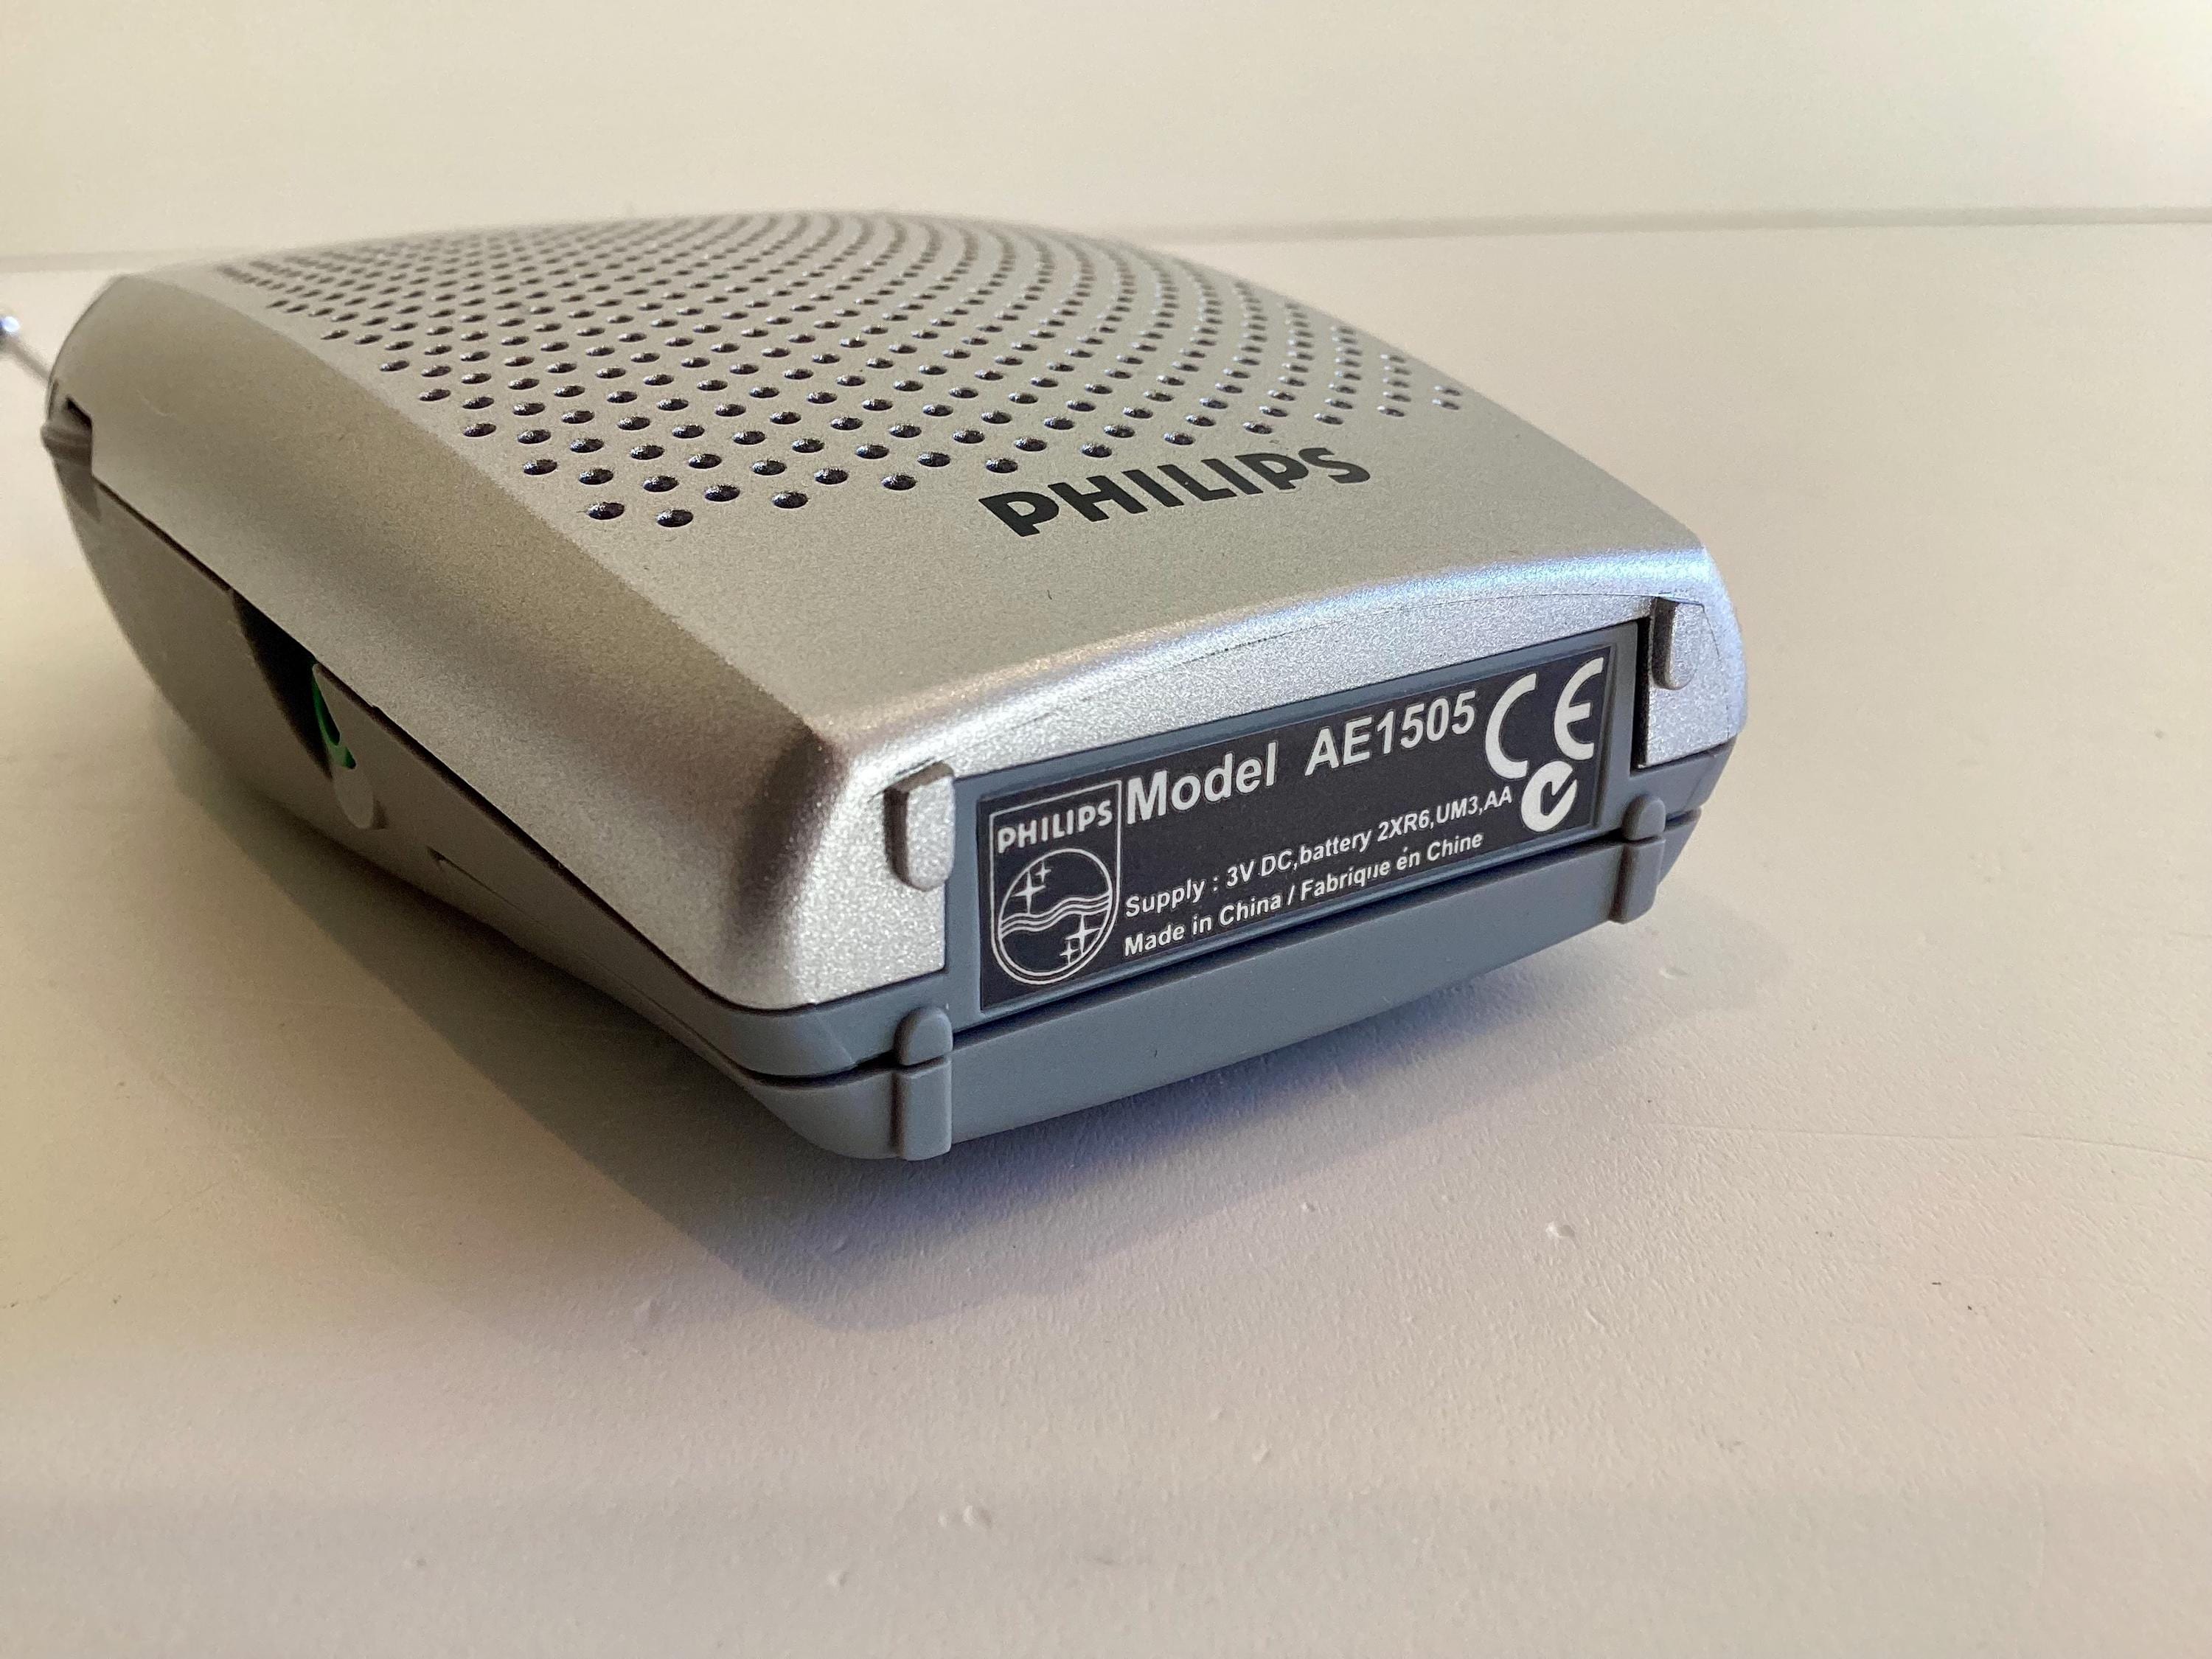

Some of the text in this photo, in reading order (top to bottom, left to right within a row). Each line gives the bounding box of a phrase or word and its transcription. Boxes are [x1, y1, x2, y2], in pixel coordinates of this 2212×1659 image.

[978, 448, 1371, 537] PHILIPS
[1125, 690, 1475, 824] Model AE1505
[1485, 656, 1604, 779] CE
[997, 799, 1113, 853] PHILIPS
[1125, 879, 1206, 919] Supply
[1226, 860, 1255, 886] 3V
[1260, 829, 1372, 875] DC,battery
[1377, 785, 1513, 843] 2XR6,UM3,AA
[1124, 924, 1185, 958] Made
[1192, 914, 1212, 936] in
[1220, 895, 1281, 926] China
[1301, 861, 1391, 902] Fabrique
[1427, 832, 1484, 862] Chine
